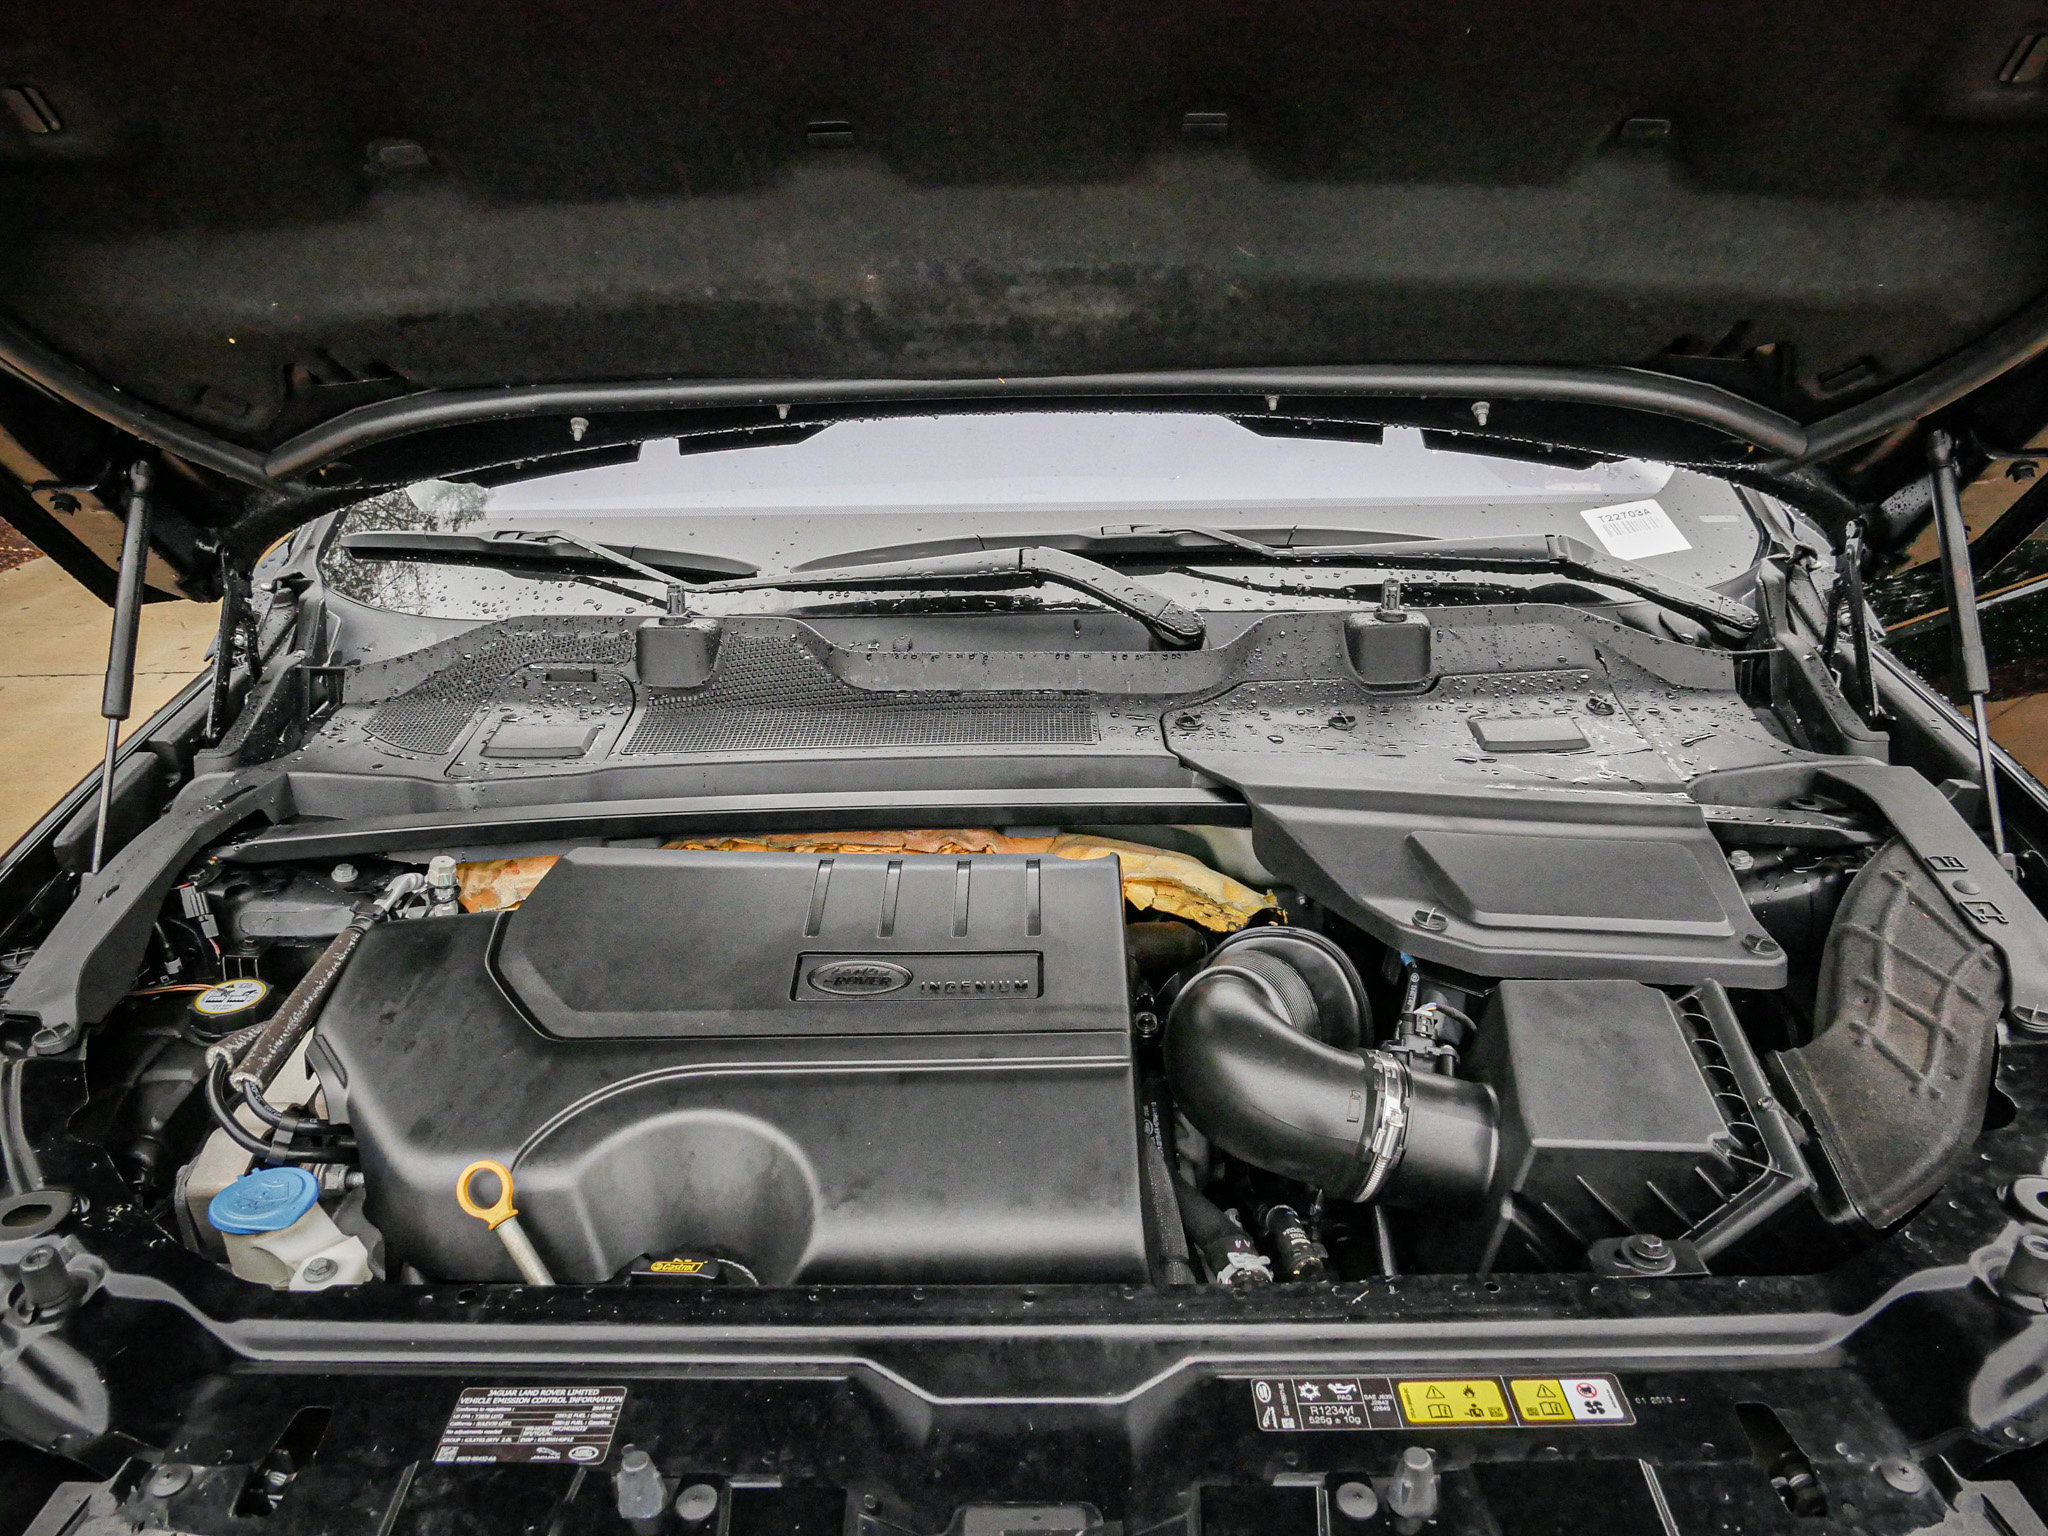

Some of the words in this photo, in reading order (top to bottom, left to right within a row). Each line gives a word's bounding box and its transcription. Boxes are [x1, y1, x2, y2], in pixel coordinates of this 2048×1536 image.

[1597, 508, 1652, 523] T22703A
[920, 980, 1029, 994] INGENIUM
[662, 1263, 695, 1271] Castrol
[487, 1389, 518, 1397] JAGUAR
[567, 1388, 600, 1396] LIMITED
[1309, 1405, 1354, 1417] R1234yf
[1343, 1416, 1361, 1425] 10g
